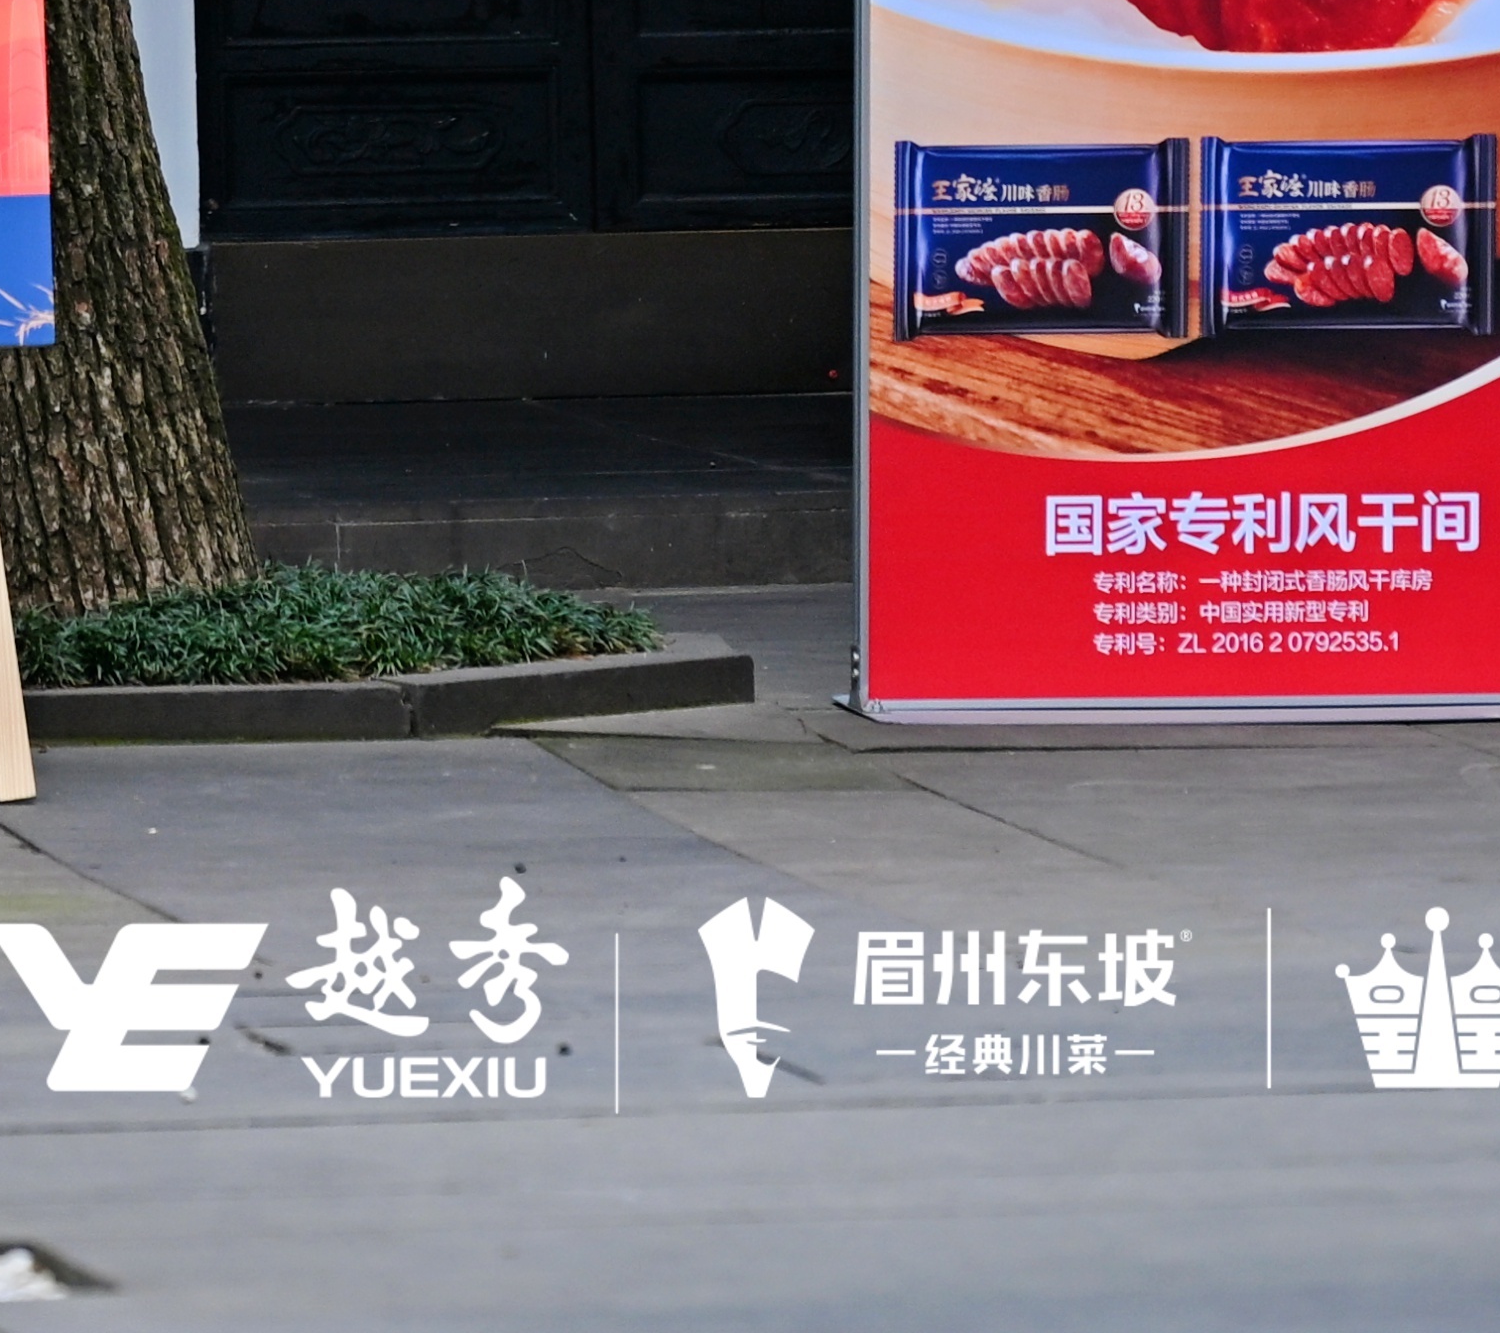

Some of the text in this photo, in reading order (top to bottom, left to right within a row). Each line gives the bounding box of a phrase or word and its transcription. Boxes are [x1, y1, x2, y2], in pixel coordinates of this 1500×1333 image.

[931, 174, 1070, 202] 王家渡 川味香肠
[1238, 169, 1376, 199] 王家渡 川味香肠
[1123, 192, 1145, 212] 13
[1430, 188, 1451, 209] 13
[1045, 490, 1480, 556] 国家专利风干间
[1211, 631, 1264, 653] 2016
[1269, 632, 1283, 653] 2
[1287, 630, 1400, 653] 0792535.1
